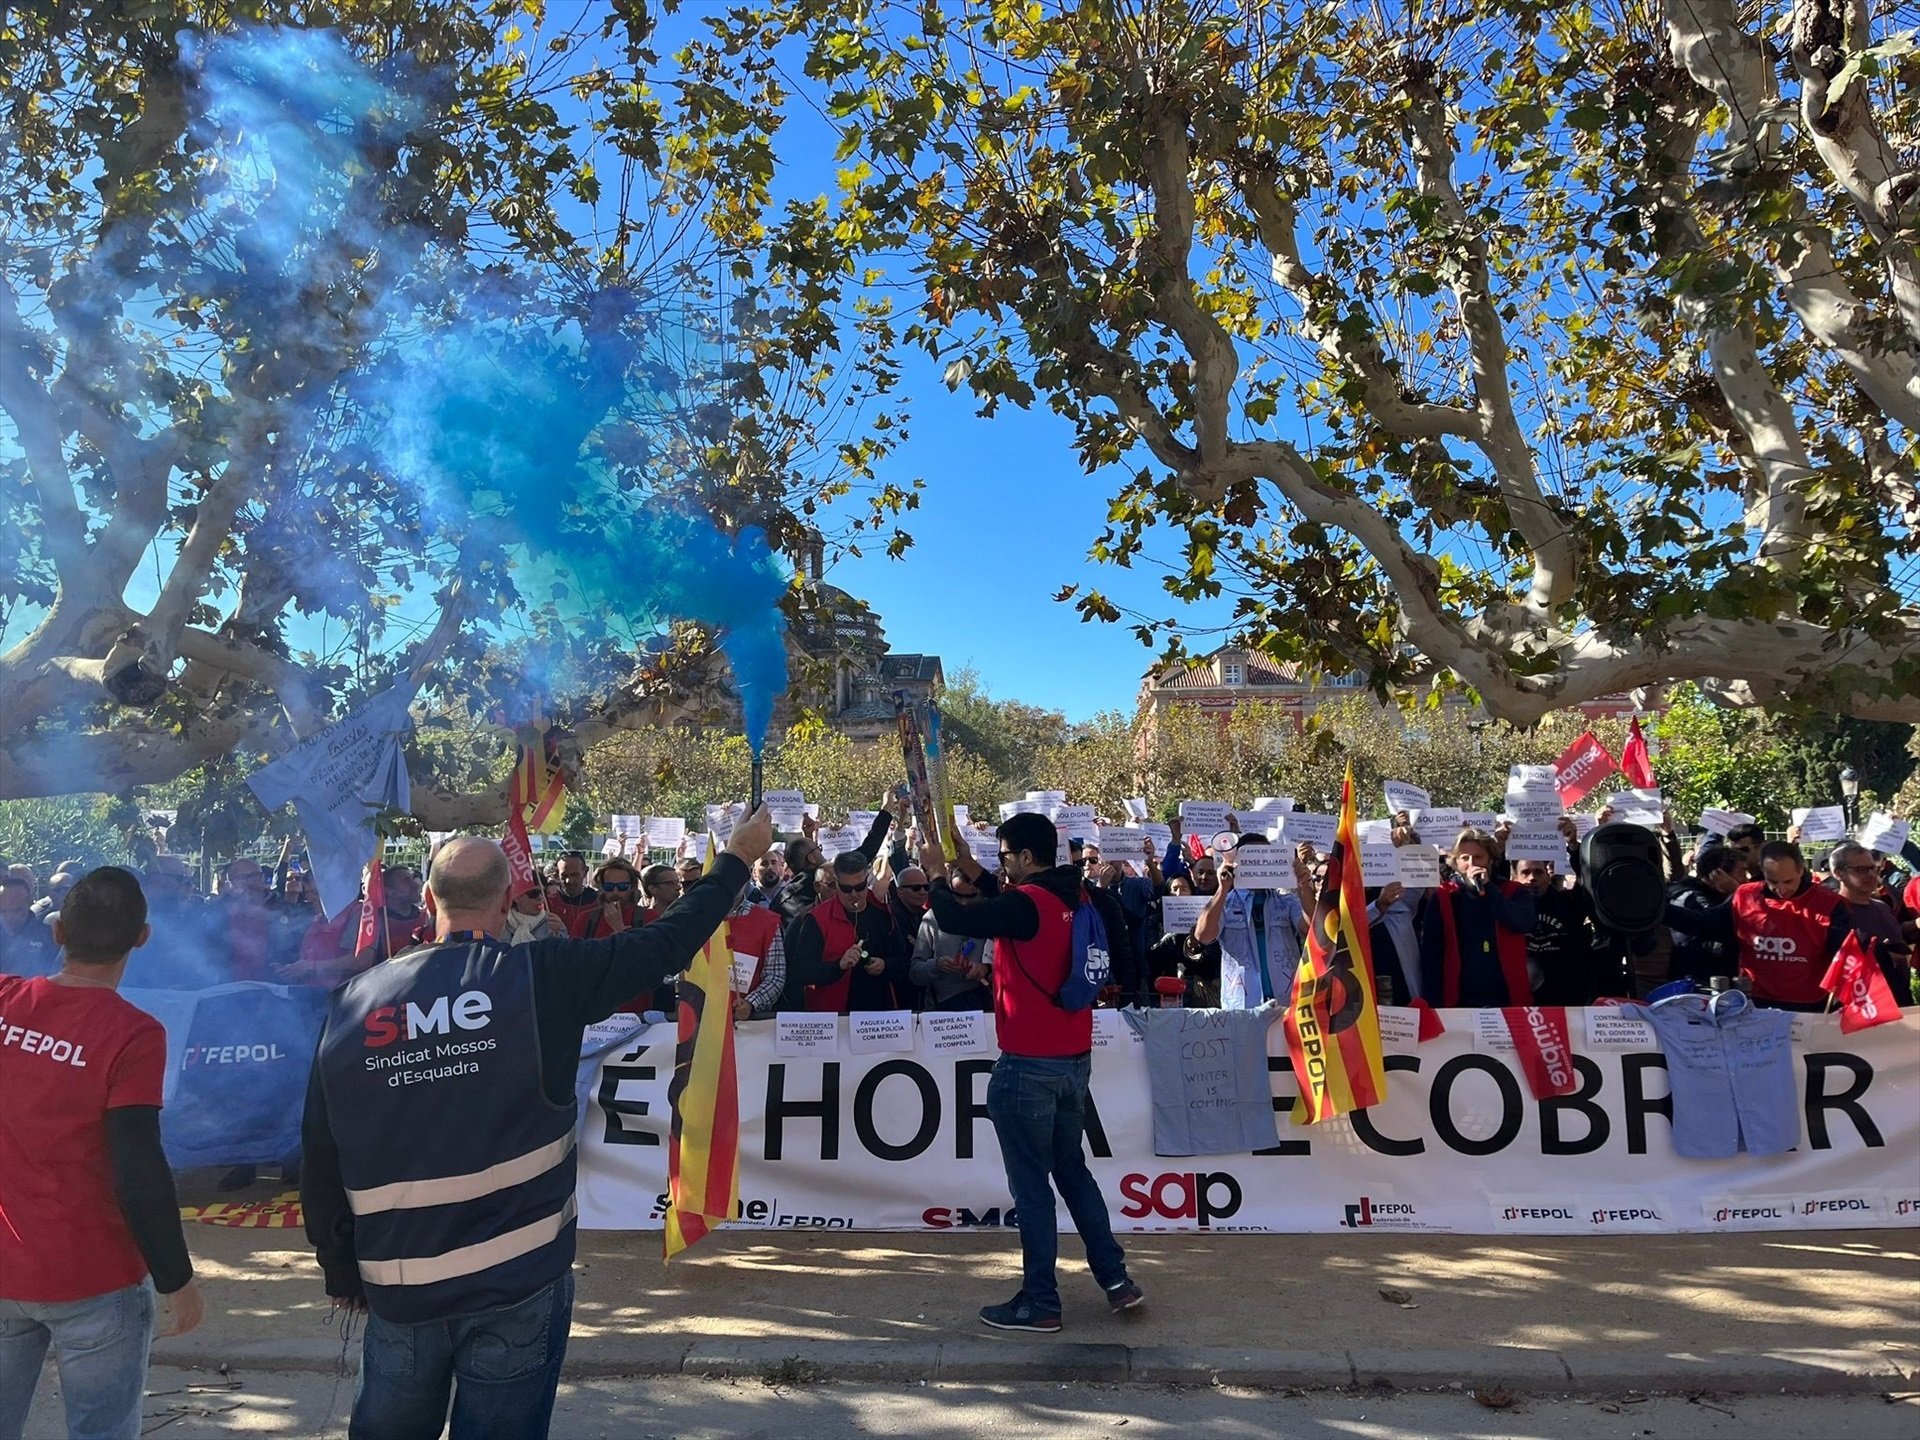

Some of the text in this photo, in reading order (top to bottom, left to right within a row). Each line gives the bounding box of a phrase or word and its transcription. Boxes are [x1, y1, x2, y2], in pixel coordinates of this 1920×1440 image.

[1753, 936, 1796, 957] sap
[929, 1017, 955, 1025] SIEMPRE
[1179, 1013, 1229, 1032] LOW
[8, 1026, 87, 1068] FEPOL
[934, 1040, 976, 1048] RECOMPENSA
[1181, 1038, 1231, 1060] COST
[1297, 1006, 1326, 1096] FEPOL
[204, 1044, 285, 1064] FEPOL
[365, 1037, 497, 1072] Sindicat Mossos
[388, 1061, 479, 1088] d'Esquadra
[1185, 1070, 1231, 1084] WINTER
[1206, 1087, 1217, 1096] IS
[598, 1046, 660, 1146] É
[1348, 1051, 1884, 1157] COBRR
[1190, 1097, 1236, 1108] COMING
[1120, 1172, 1243, 1226] sap
[1819, 1199, 1871, 1212] FEPOL
[1379, 1204, 1416, 1214] FEPOL
[1521, 1207, 1573, 1220] FEPOL
[1609, 1208, 1662, 1221] FEPOL
[1732, 1207, 1782, 1219] FEPOL
